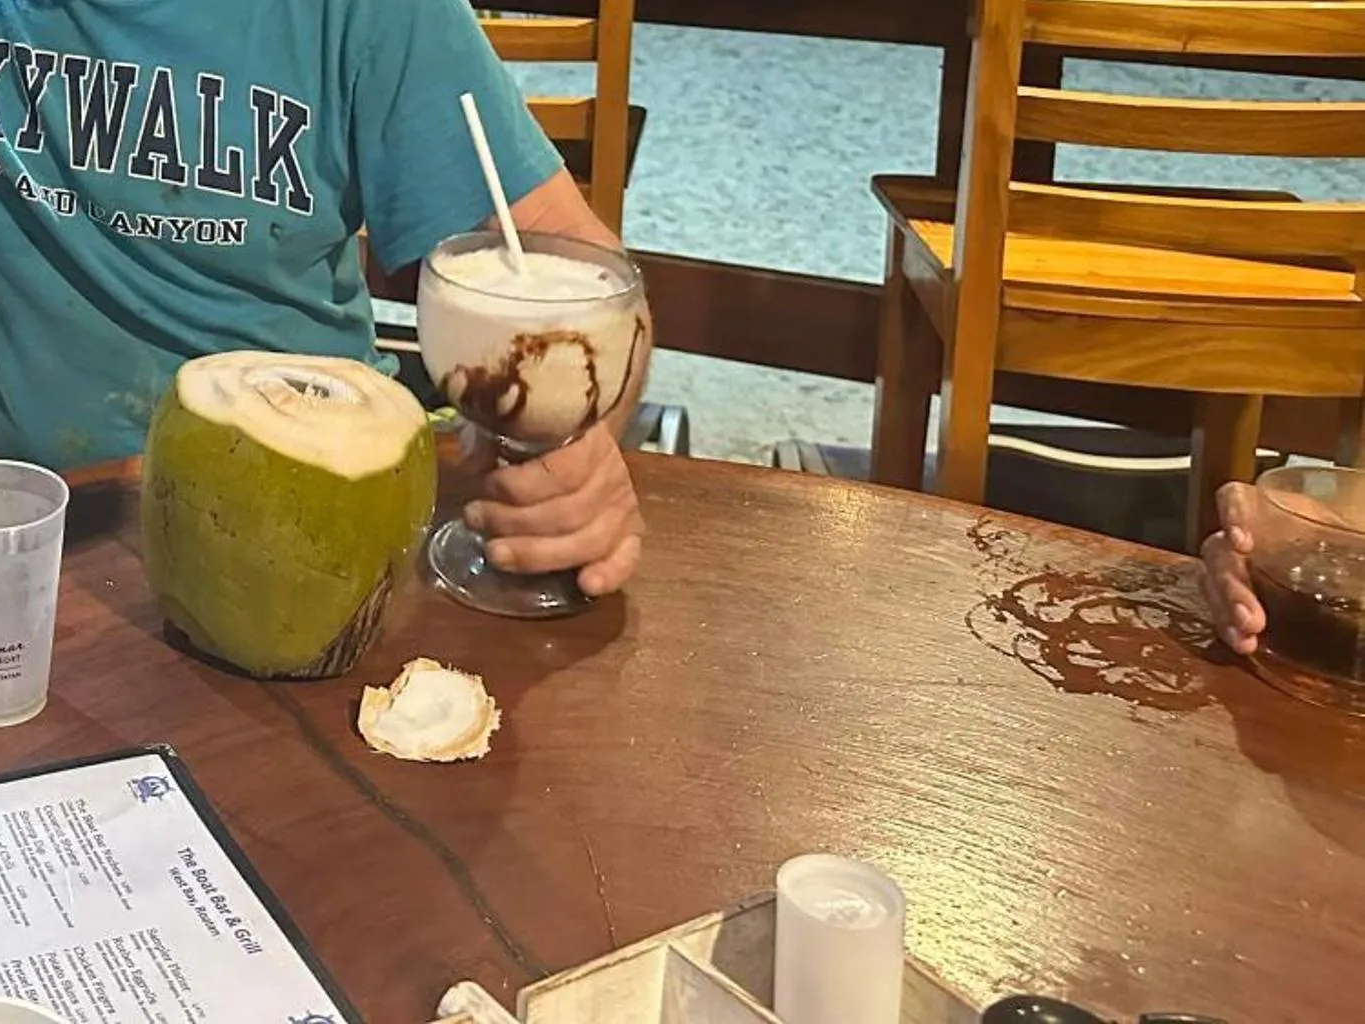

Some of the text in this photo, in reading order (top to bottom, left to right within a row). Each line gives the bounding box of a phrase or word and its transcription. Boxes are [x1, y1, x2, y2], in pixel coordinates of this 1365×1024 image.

[57, 837, 85, 867] Shrimp
[81, 814, 100, 832] Boat
[92, 834, 108, 847] Bar
[100, 848, 126, 877] Nachos
[166, 867, 223, 936] West Bay, Roatan
[175, 847, 265, 955] The Boat Bar & Grill
[8, 959, 33, 987] Pretzel
[43, 952, 68, 979] Potato
[59, 979, 82, 1004] Skins
[71, 945, 99, 980] Chicken
[88, 980, 119, 1014] Fingers
[143, 928, 175, 961] Sampler
[166, 962, 194, 991] Platter
